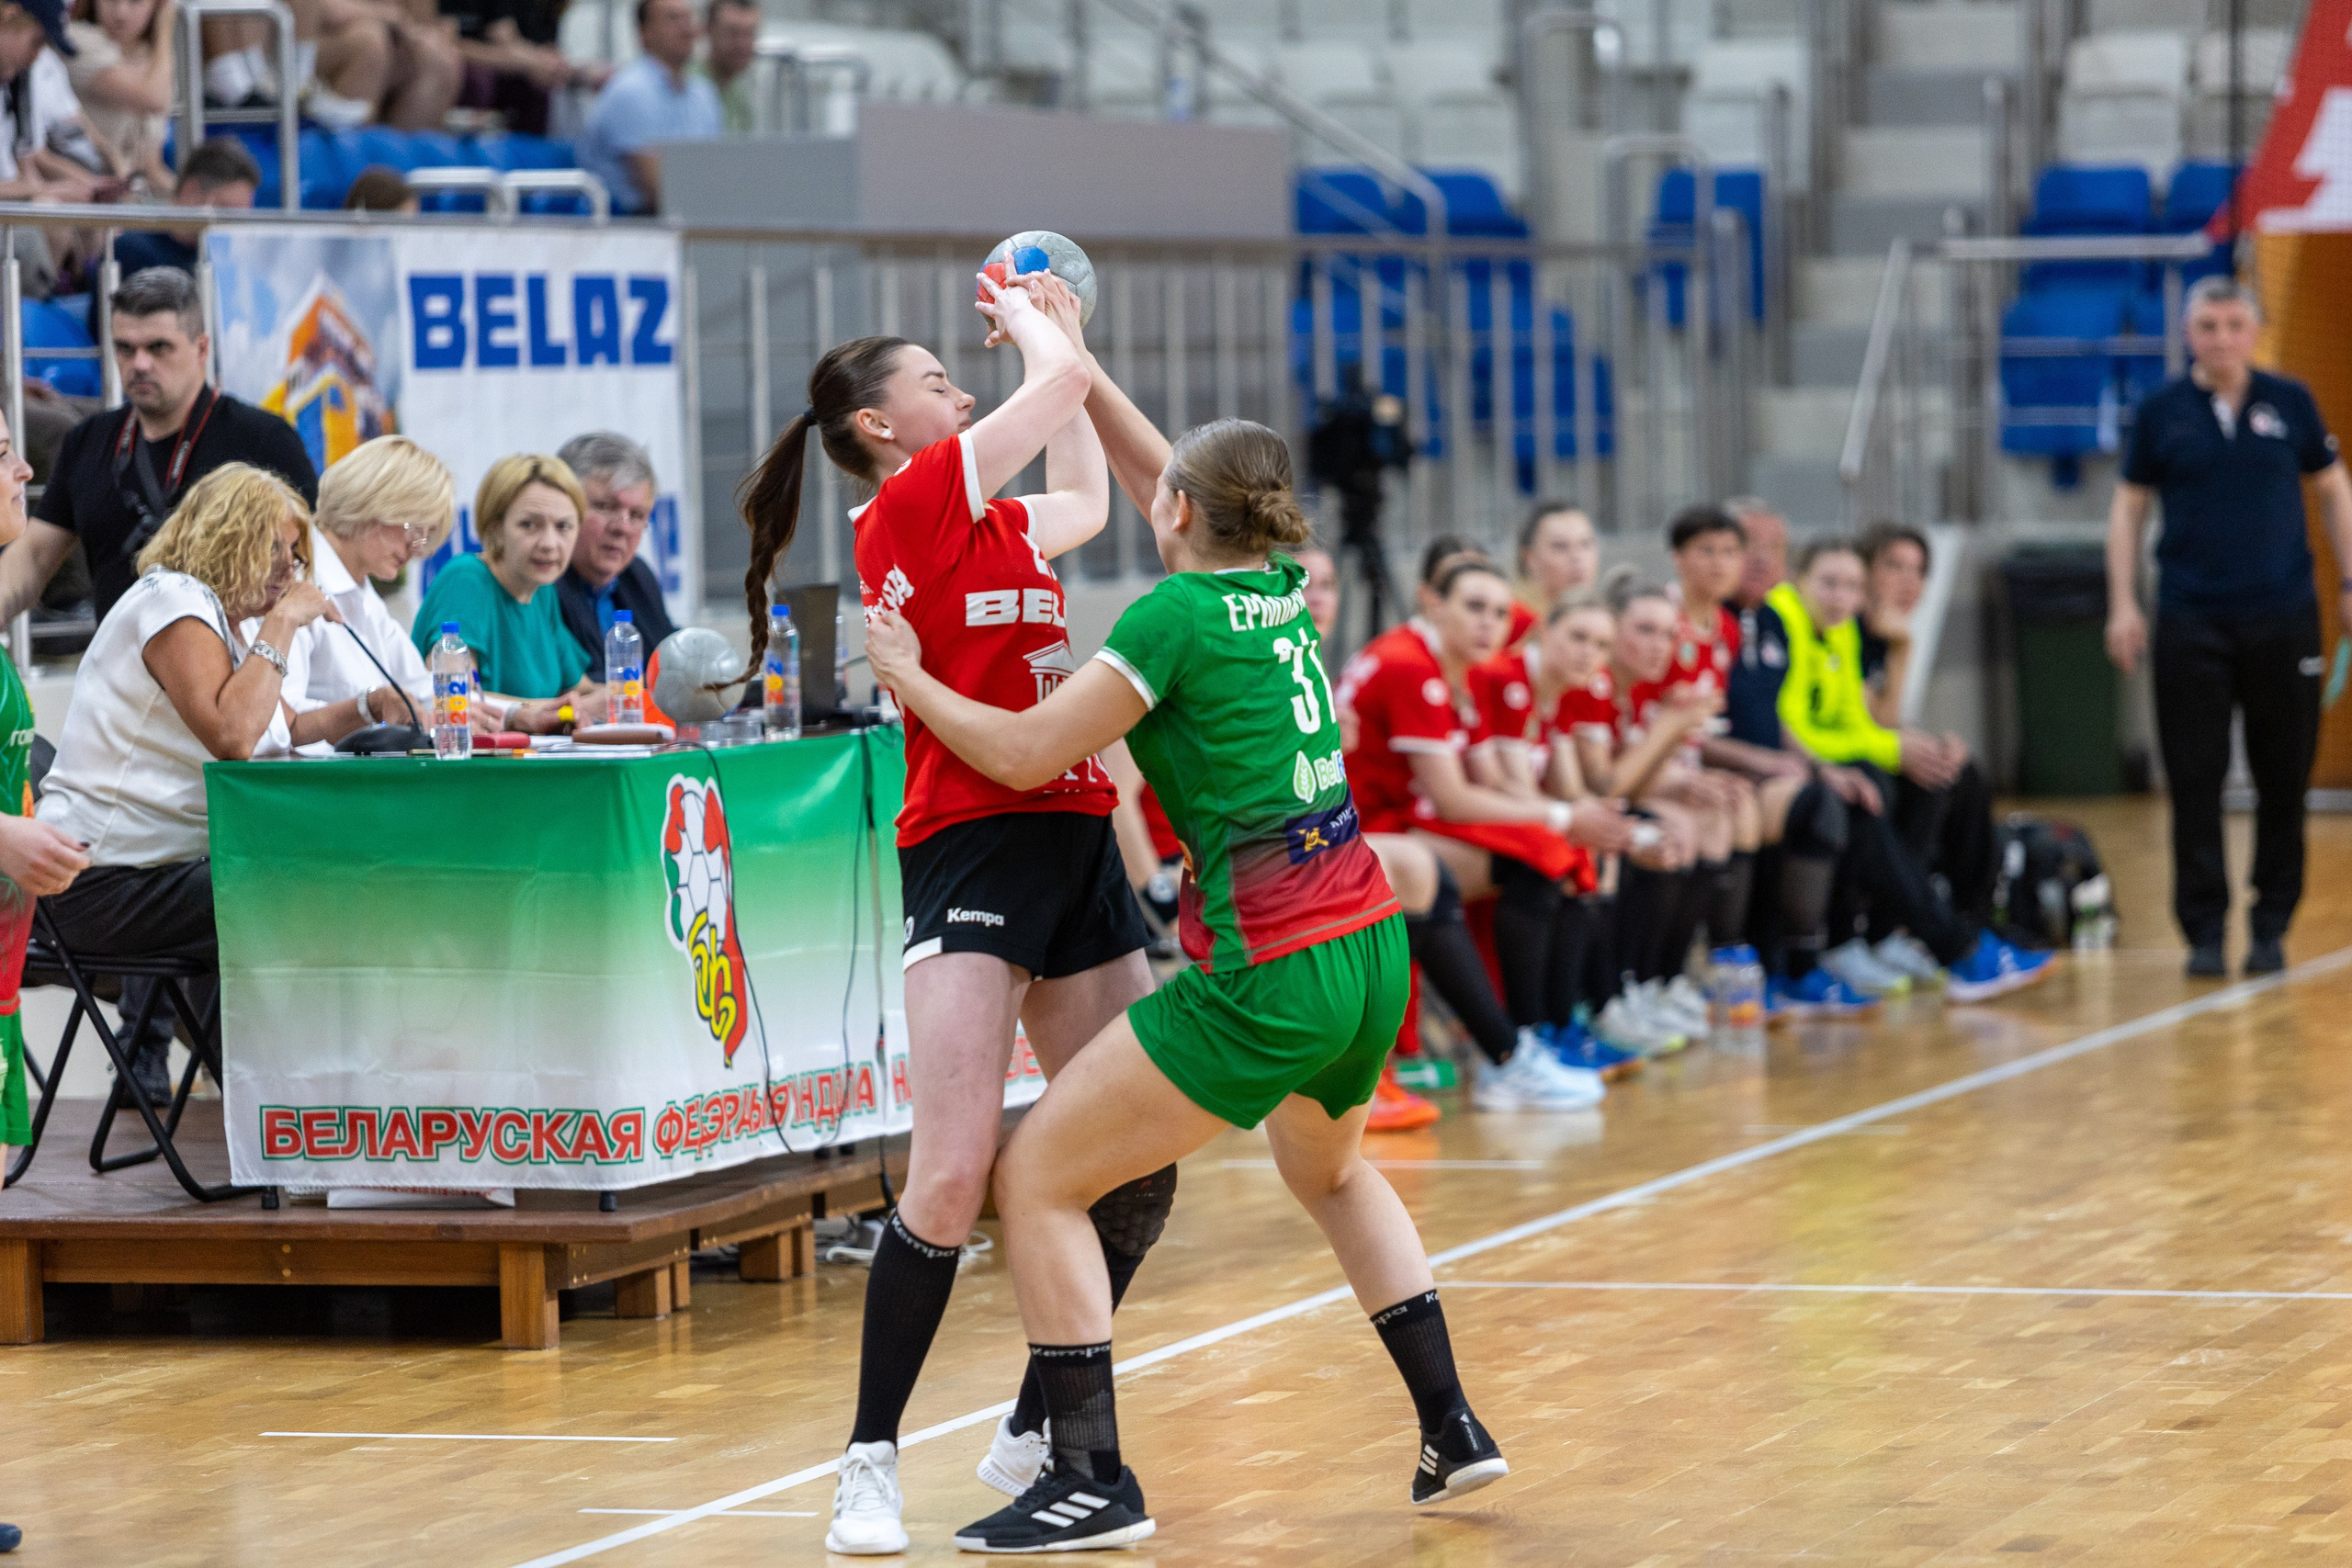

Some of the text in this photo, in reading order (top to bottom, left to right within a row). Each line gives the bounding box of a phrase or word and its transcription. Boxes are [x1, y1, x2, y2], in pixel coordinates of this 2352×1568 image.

[410, 276, 673, 368] BELAZ
[966, 588, 1067, 628] BEL
[1272, 627, 1337, 734] 31
[448, 681, 467, 725] 202
[947, 907, 1005, 927] Kempa
[261, 1107, 645, 1164] БЕЛАРУСКАЯ
[891, 1215, 956, 1259] Kempa
